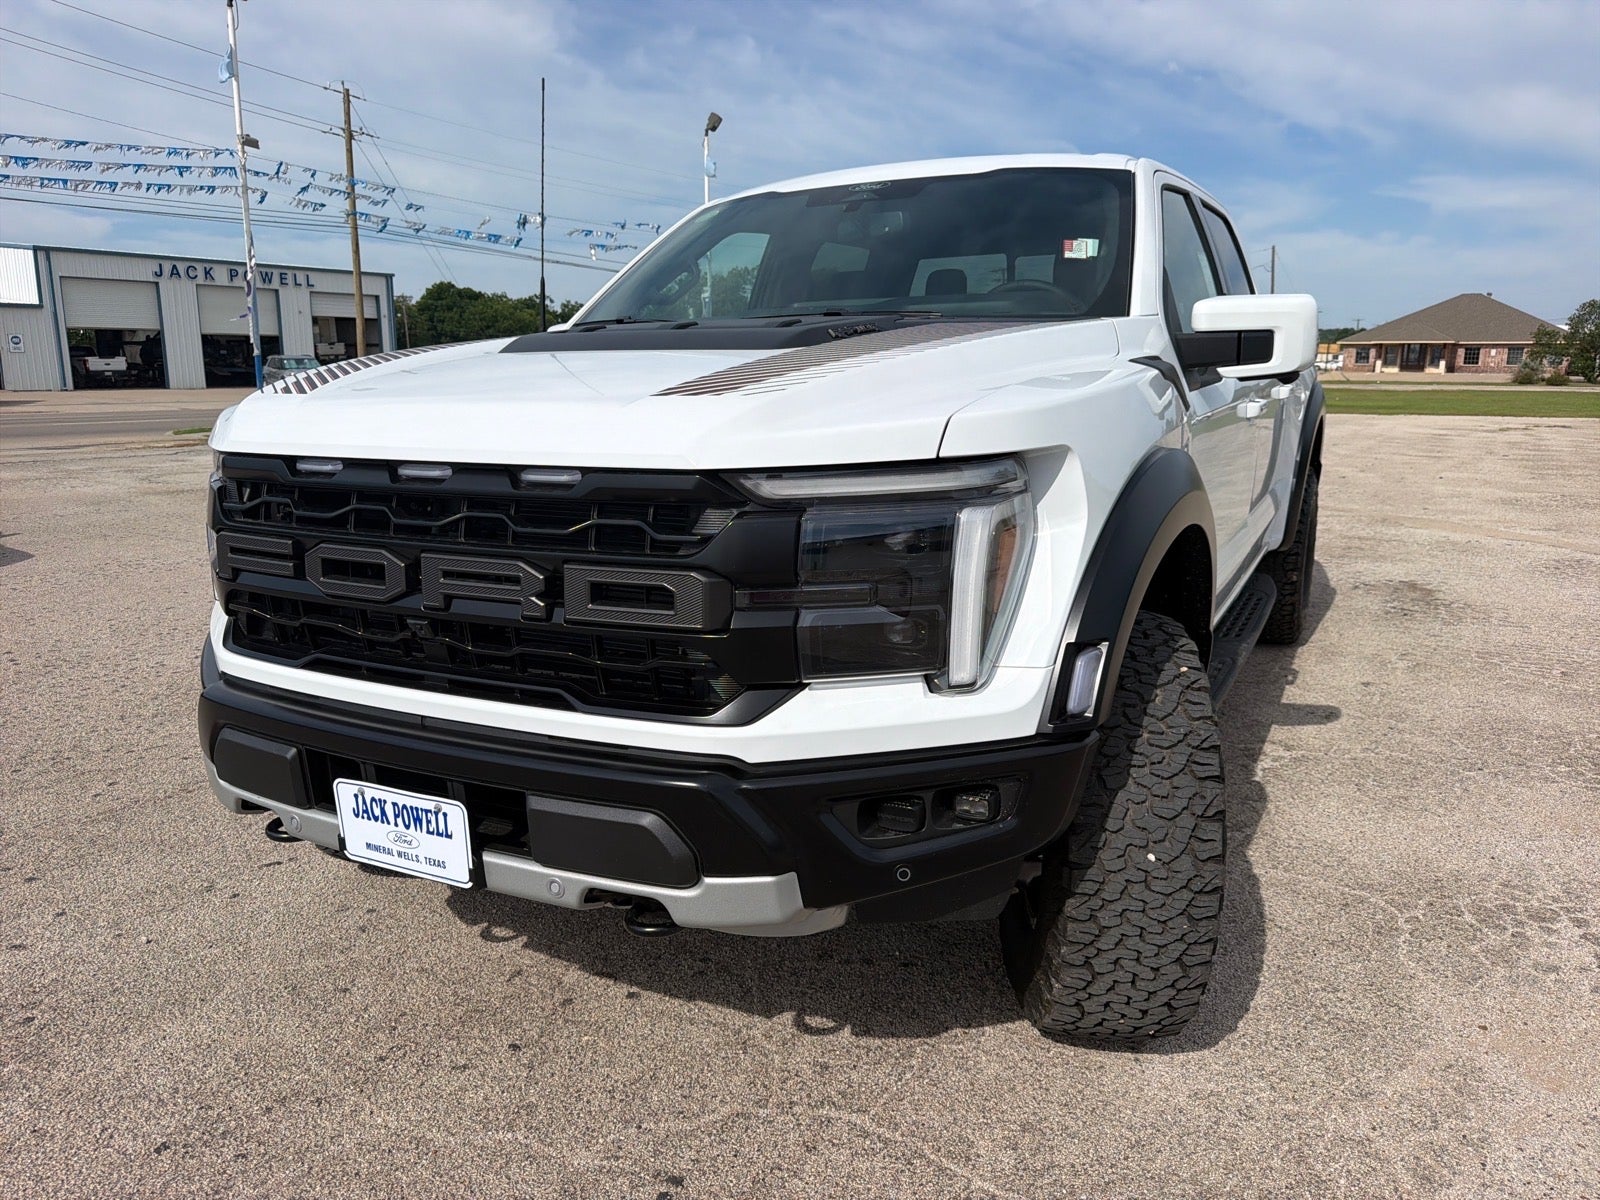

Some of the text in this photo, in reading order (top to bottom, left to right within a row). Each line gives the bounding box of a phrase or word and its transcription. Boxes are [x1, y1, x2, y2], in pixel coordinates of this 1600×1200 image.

[154, 263, 215, 281] JACK
[215, 530, 731, 637] FORD
[352, 793, 453, 840] JACK POWELL
[393, 832, 413, 847] Ford
[365, 842, 395, 857] MINERAL
[424, 856, 447, 870] TEXAS
